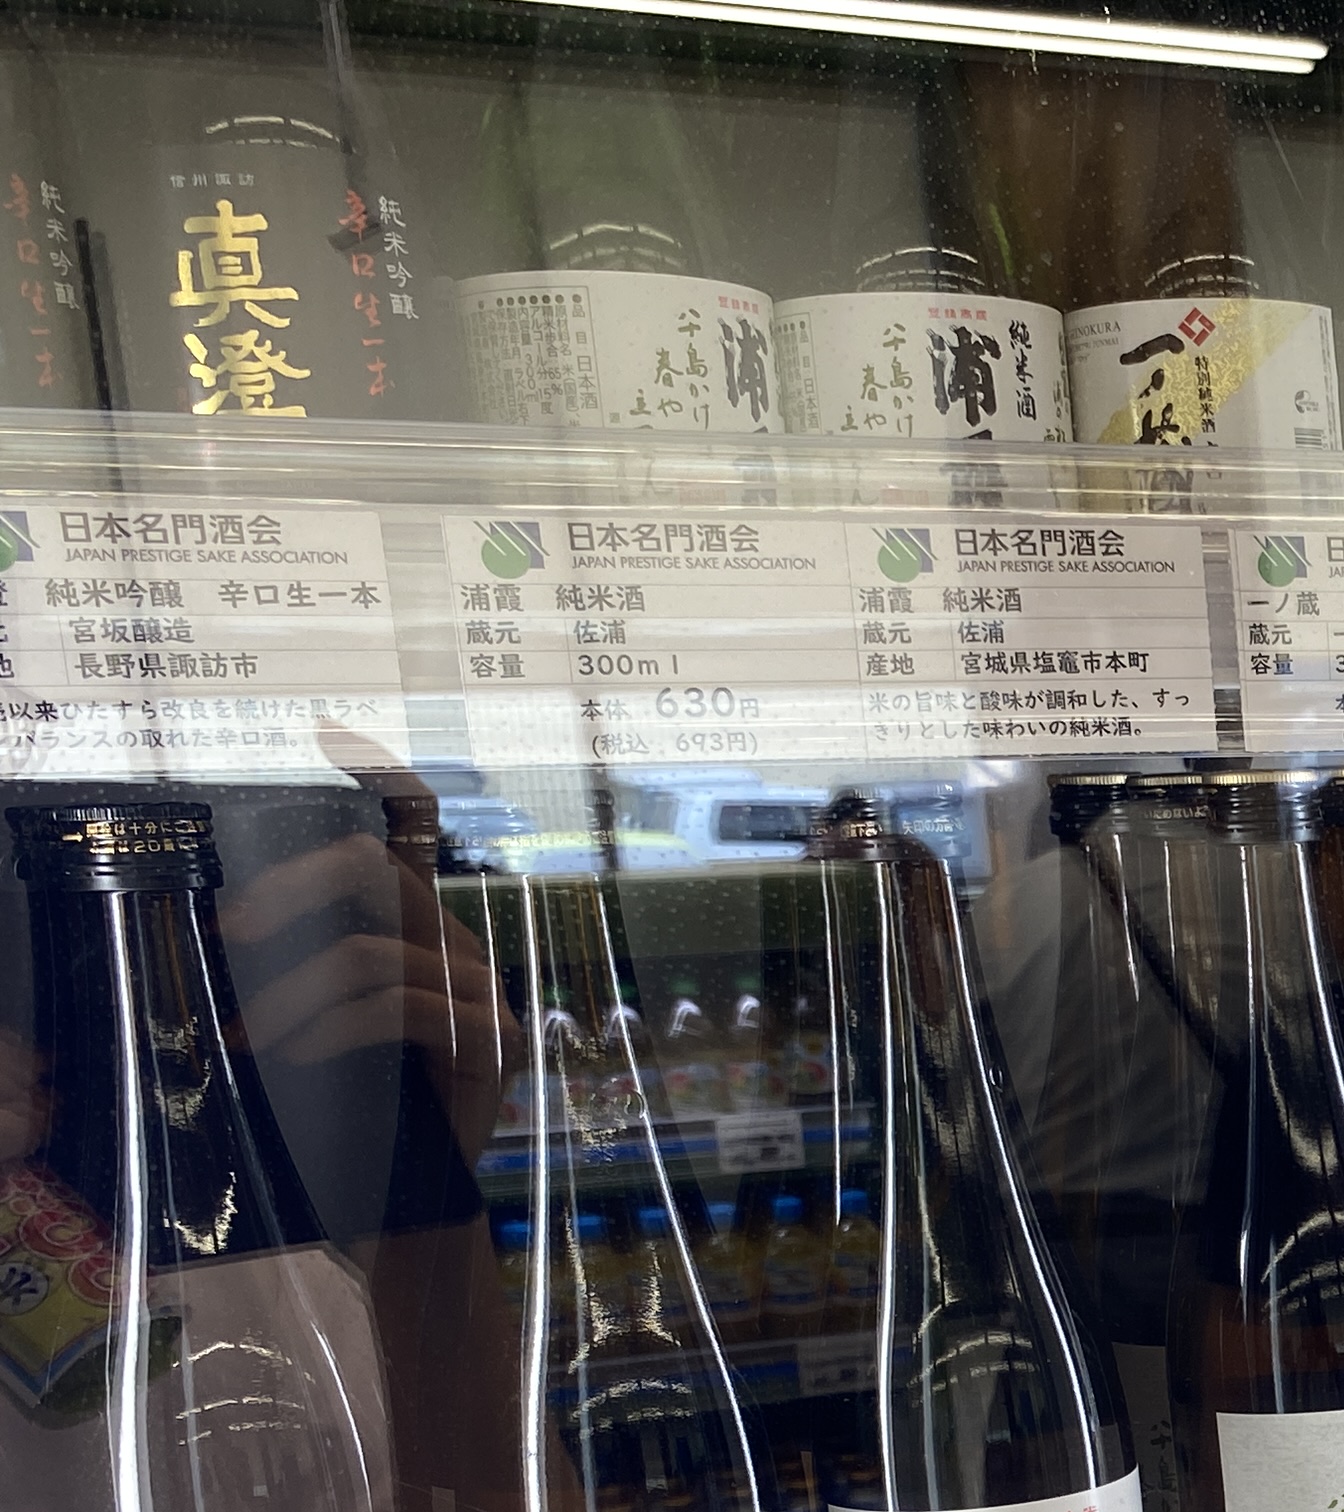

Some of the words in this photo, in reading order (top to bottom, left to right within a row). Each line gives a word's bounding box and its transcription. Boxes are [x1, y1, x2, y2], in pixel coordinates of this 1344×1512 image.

[378, 196, 419, 319] 純米吟醸
[169, 200, 311, 417] 真澄
[1008, 320, 1037, 420] 純米酒
[60, 512, 282, 545] 日本名門酒会
[568, 522, 759, 552] 日本名門酒会
[954, 528, 1124, 557] 日本名門酒会
[45, 580, 185, 608] 純米吟醸
[219, 581, 381, 609] 辛口生一本
[461, 584, 524, 612] 浦霞
[556, 584, 645, 612] 純米酒
[860, 588, 913, 613] 浦霞
[943, 588, 1021, 612] 純米酒
[1248, 593, 1320, 615] 一ノ蔵
[69, 618, 195, 644] 宮坂醸造
[465, 621, 521, 645] 蔵元
[573, 621, 626, 644] 佐浦
[863, 622, 912, 644] 蔵元
[958, 621, 1004, 644] 佐浦
[1249, 624, 1292, 645] 蔵元
[75, 654, 258, 679] 長野県諏訪市
[470, 654, 525, 678] 容量
[578, 654, 679, 675] 300ml
[866, 653, 914, 676] 産地
[961, 651, 1149, 674] 宮城県塩竈市本町
[581, 699, 628, 721] 本体
[656, 688, 759, 718] 630円
